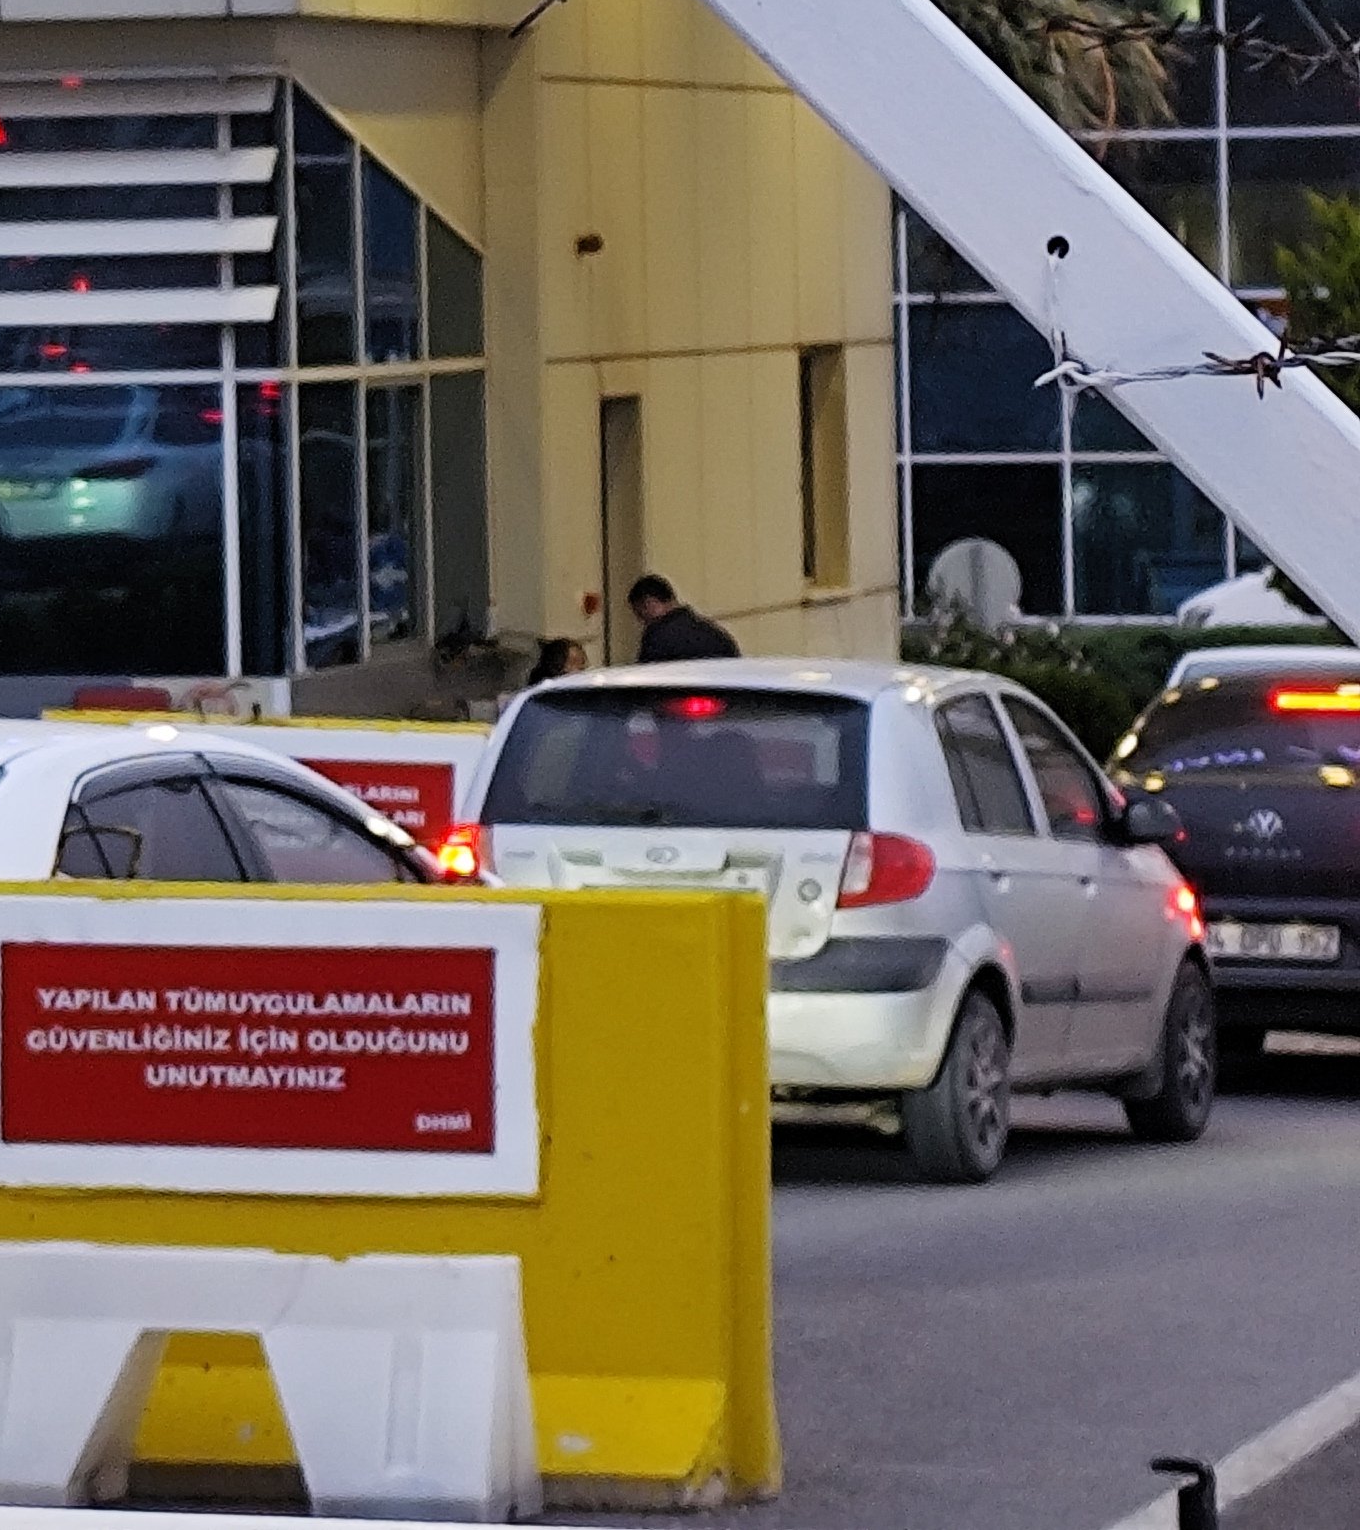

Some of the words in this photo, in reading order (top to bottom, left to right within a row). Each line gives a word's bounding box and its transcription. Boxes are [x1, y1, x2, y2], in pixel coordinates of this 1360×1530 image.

[37, 987, 158, 1012] YAPILAN
[25, 1024, 232, 1053] GÜVENLİĞİNİZ
[238, 1024, 300, 1058] İÇİN
[306, 1026, 470, 1055] OLDUĞUNU
[144, 1064, 347, 1092] UNUTMAYINIZ
